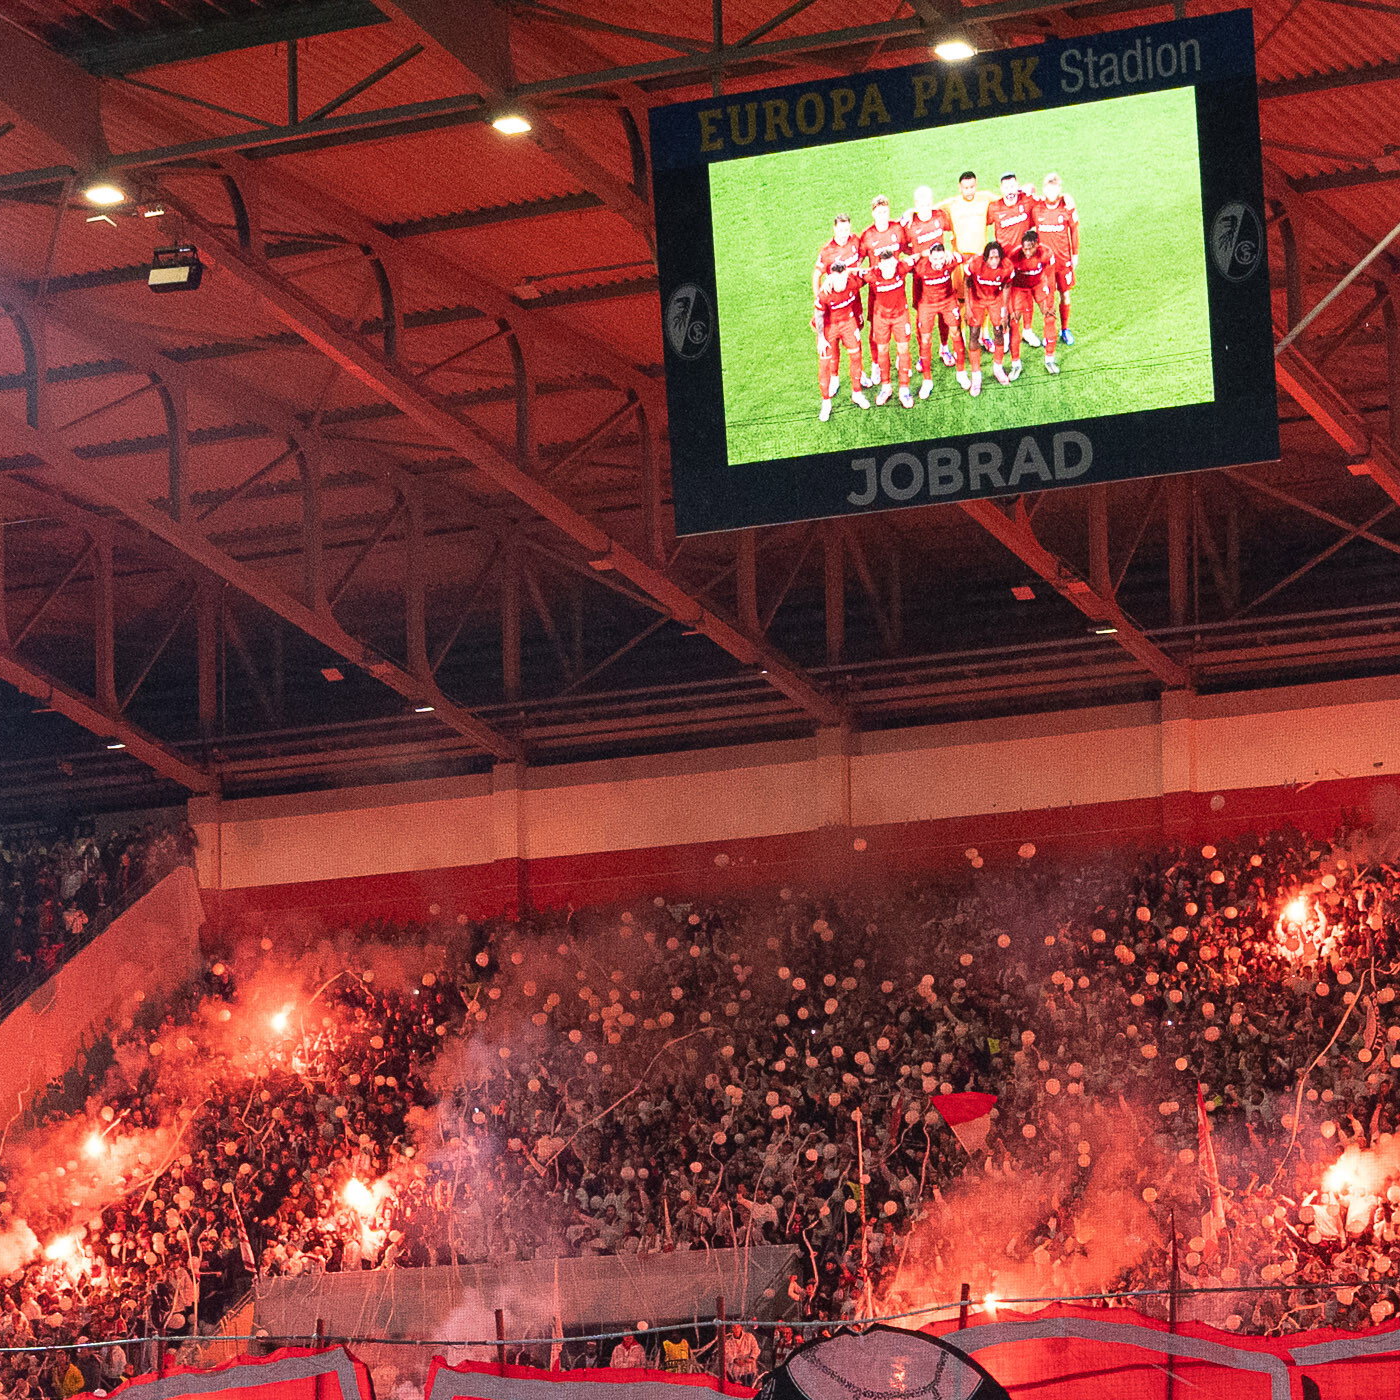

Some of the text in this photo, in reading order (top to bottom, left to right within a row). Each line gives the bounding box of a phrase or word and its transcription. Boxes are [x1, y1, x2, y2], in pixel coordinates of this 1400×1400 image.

[699, 37, 1202, 153] EUROPA PARK Stadion
[847, 430, 1094, 506] JOBRAD
